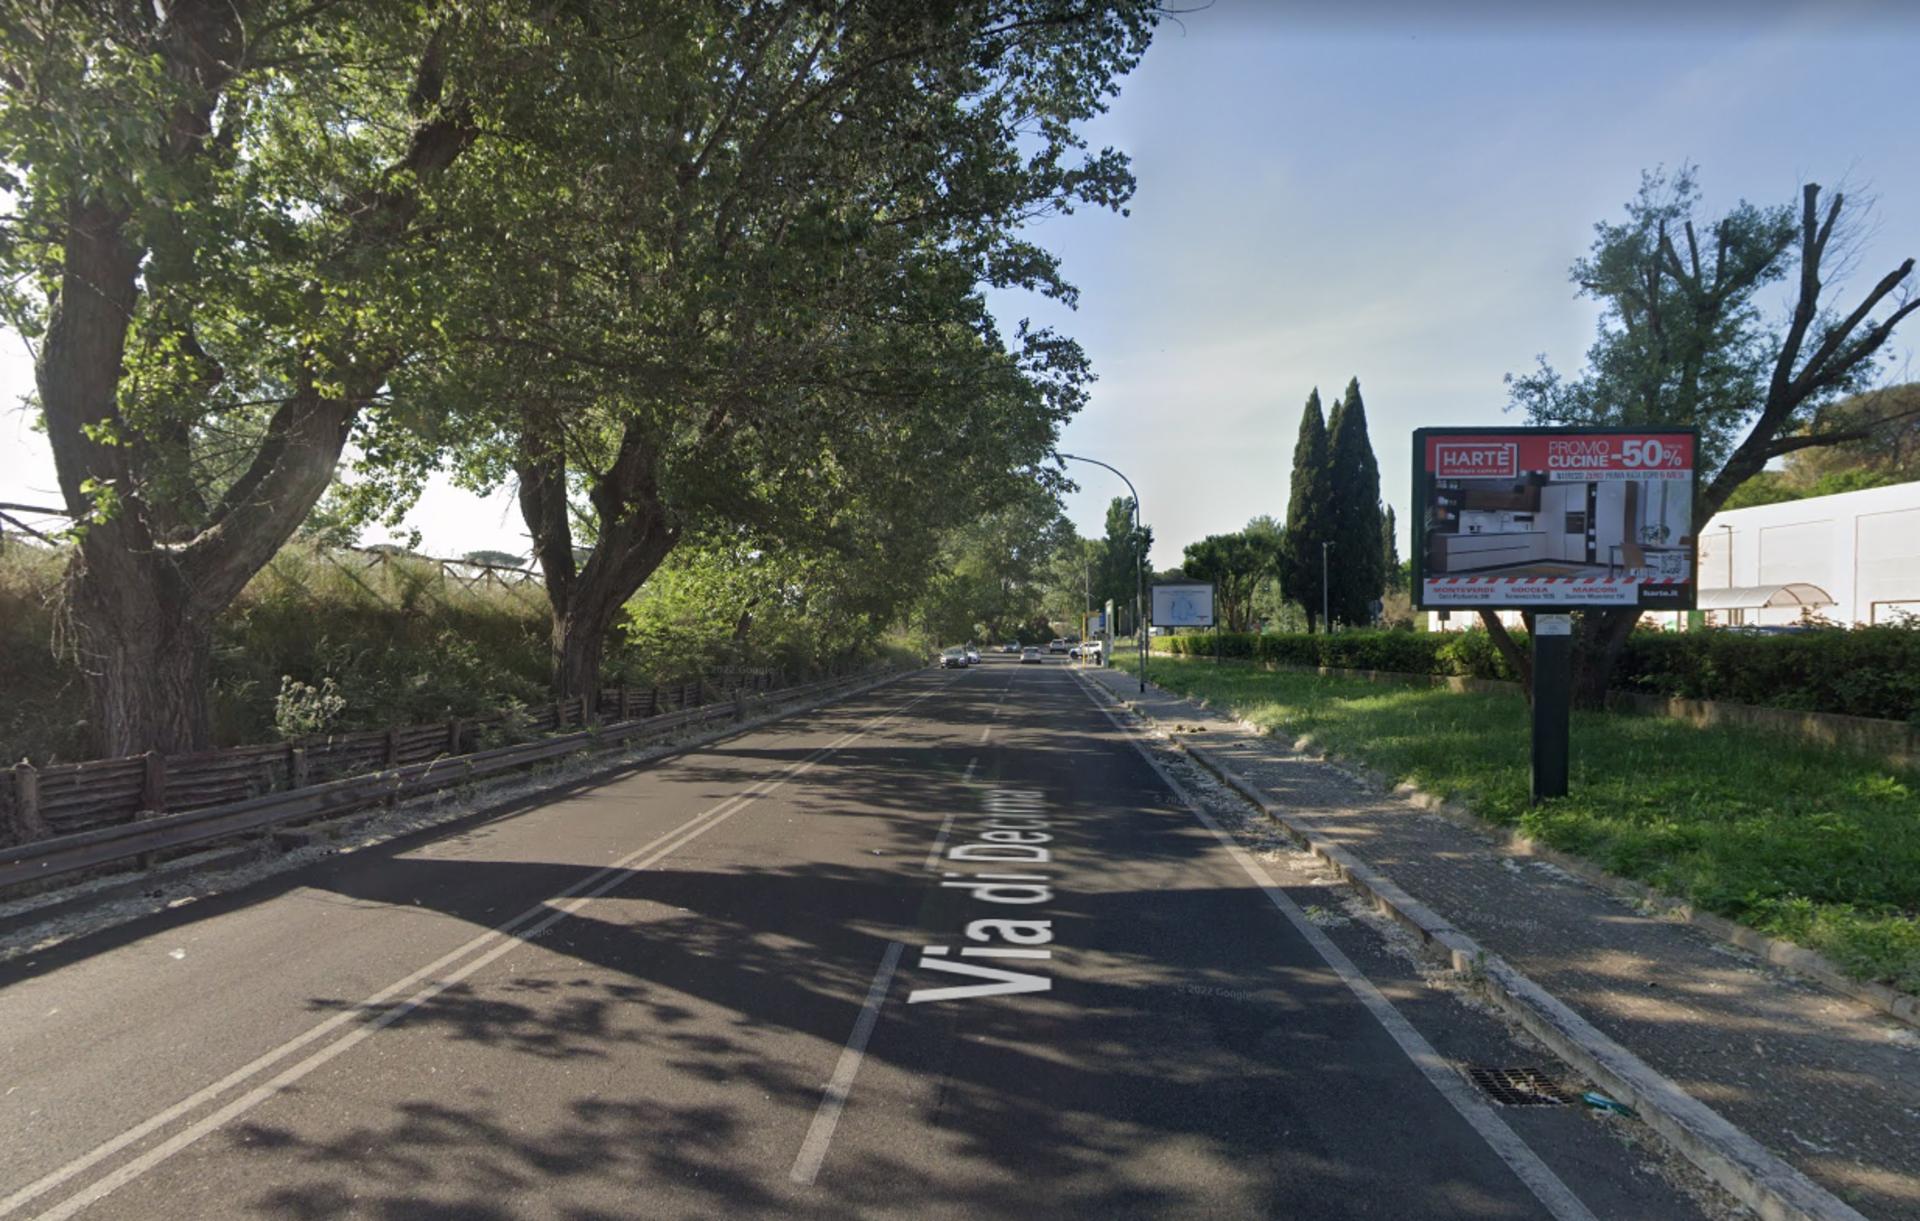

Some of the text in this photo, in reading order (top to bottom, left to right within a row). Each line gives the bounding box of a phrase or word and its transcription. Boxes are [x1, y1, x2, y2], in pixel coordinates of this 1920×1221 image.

[1549, 440, 1610, 455] PROMO
[1611, 439, 1682, 467] -50%
[1548, 455, 1609, 468] CUCINE
